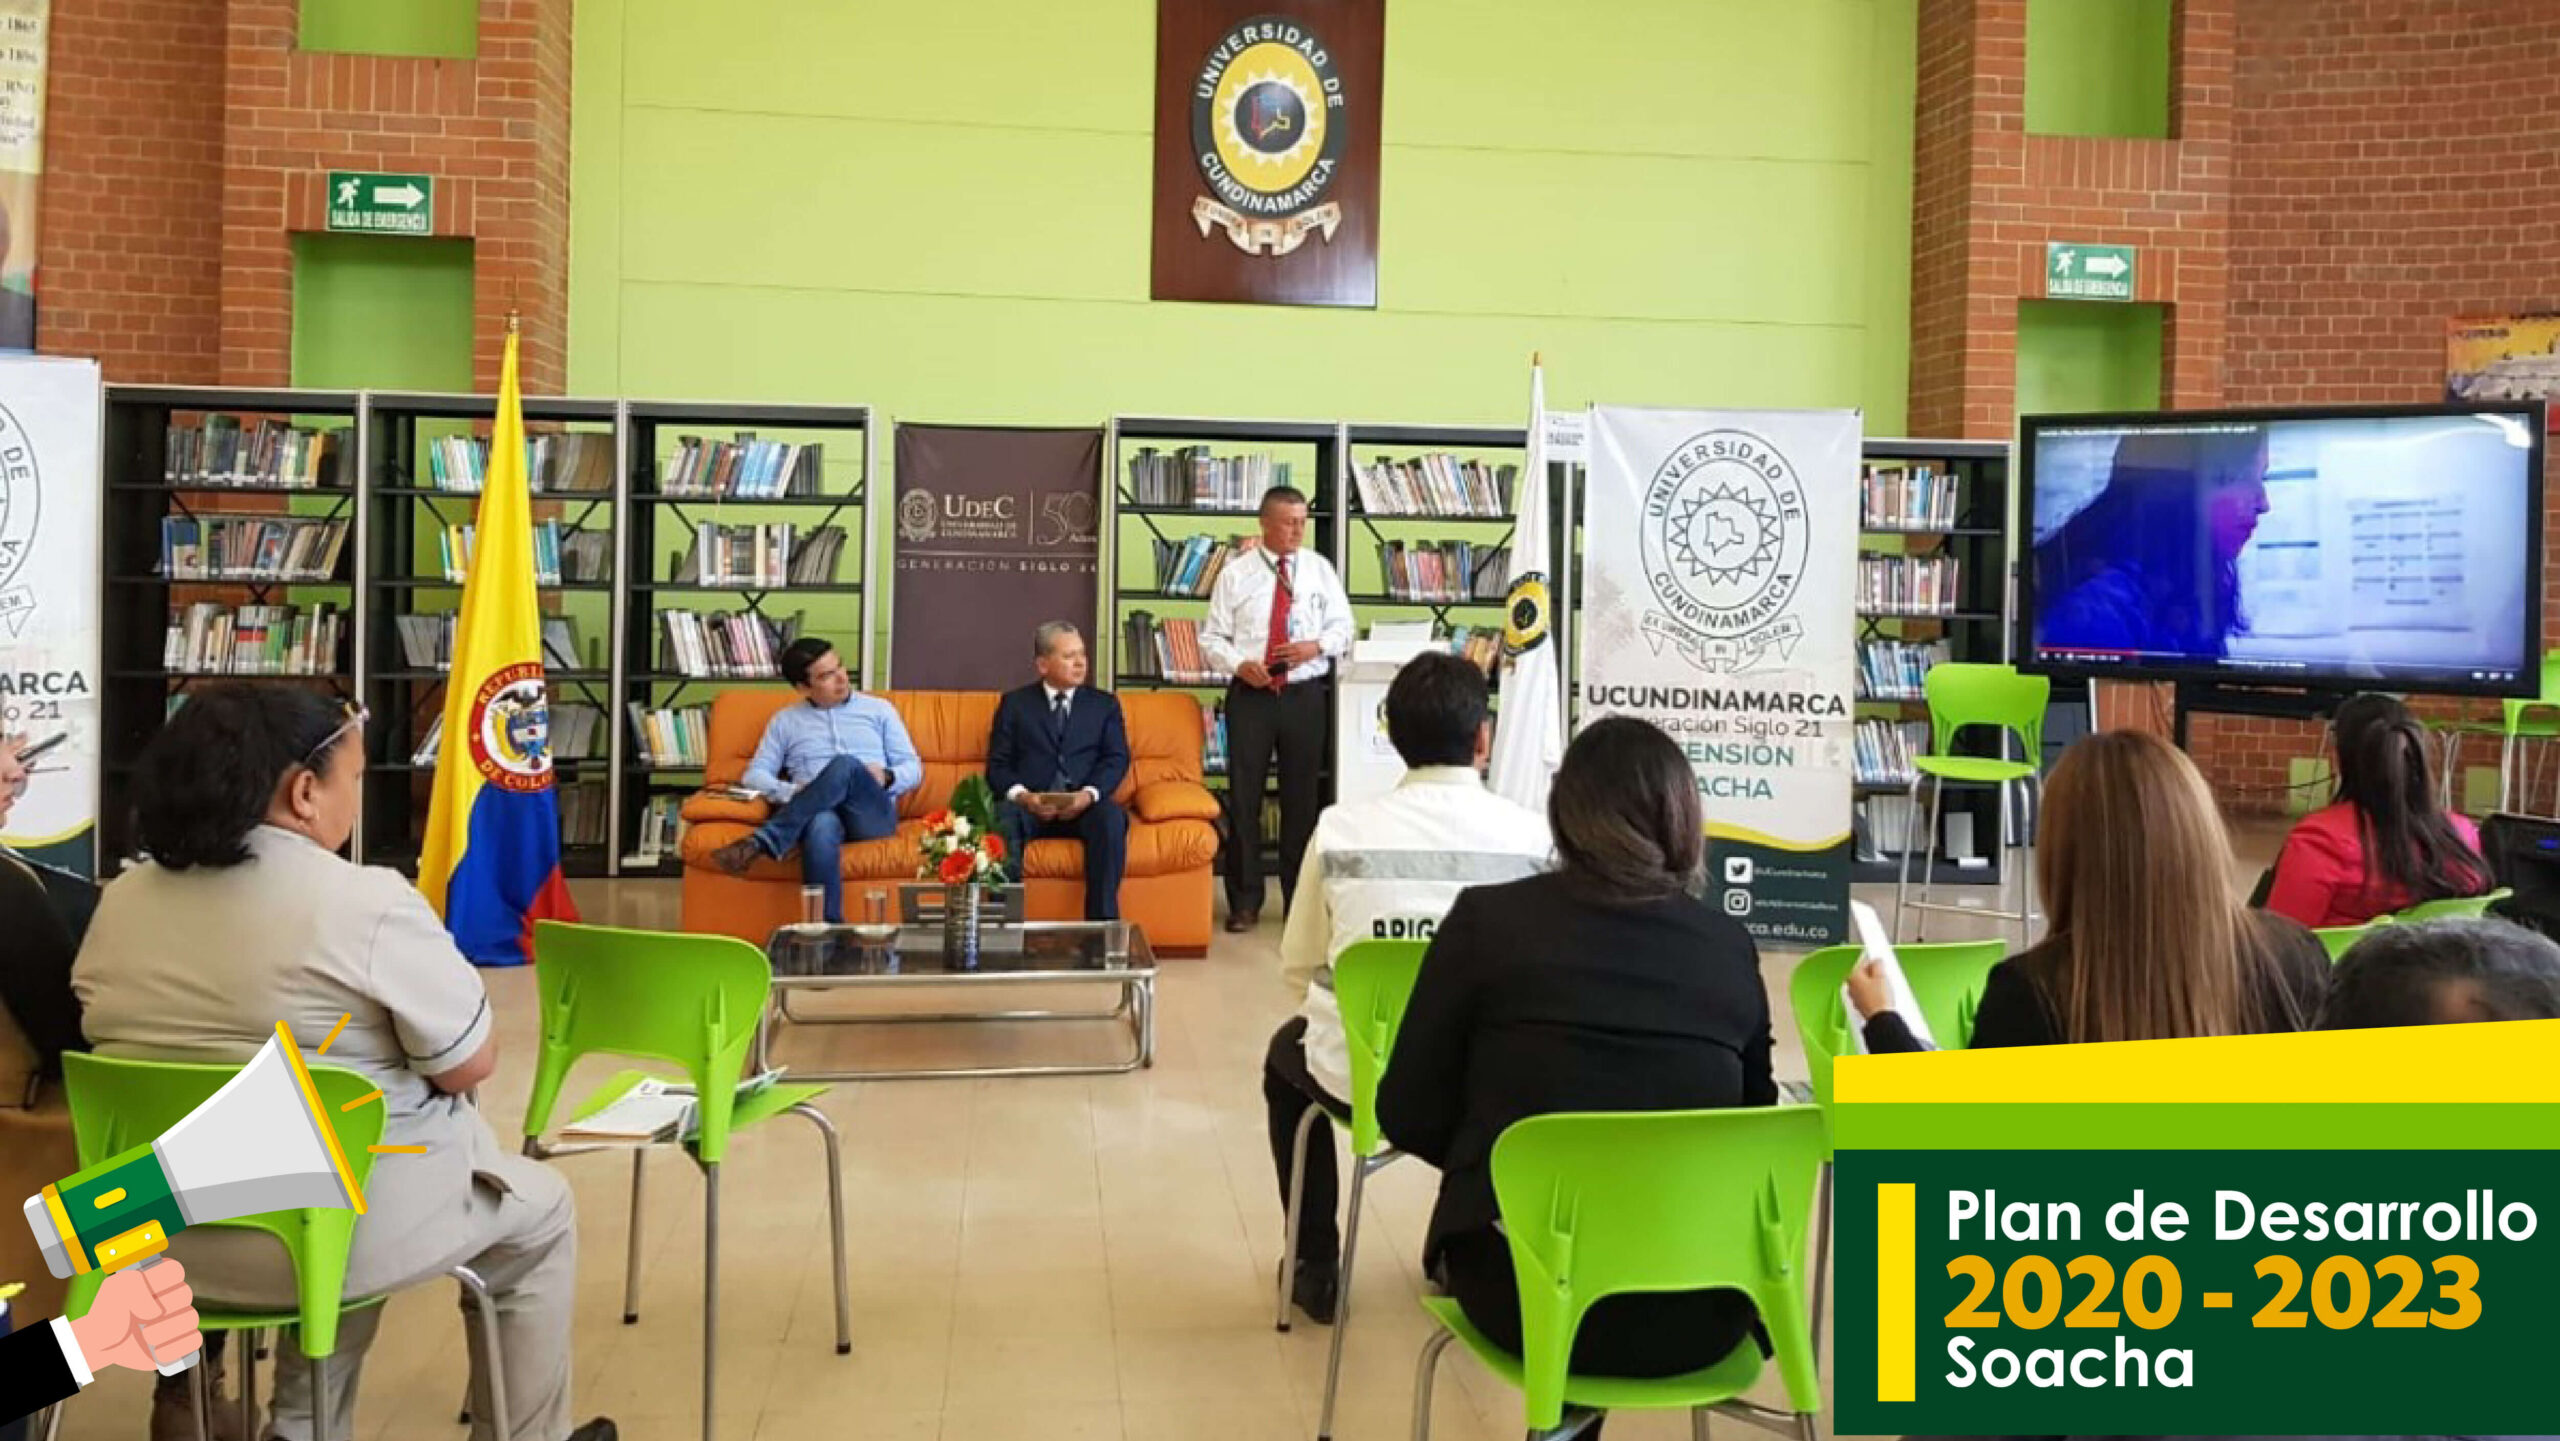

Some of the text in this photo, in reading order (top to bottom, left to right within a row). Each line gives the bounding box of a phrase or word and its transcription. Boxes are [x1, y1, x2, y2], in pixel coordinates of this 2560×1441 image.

[1197, 23, 1344, 108] UNIVERSIDAD DE
[1201, 152, 1335, 213] CUNDINAMARCA
[4, 447, 30, 480] DE
[1649, 440, 1801, 520] UNIVERSIDAD DE
[1654, 572, 1793, 629] CUNDINAMARCA
[28, 699, 63, 719] 21
[1588, 685, 1846, 716] UCUNDINAMARCA
[1732, 714, 1790, 740] Siglo
[1794, 719, 1824, 738] 21
